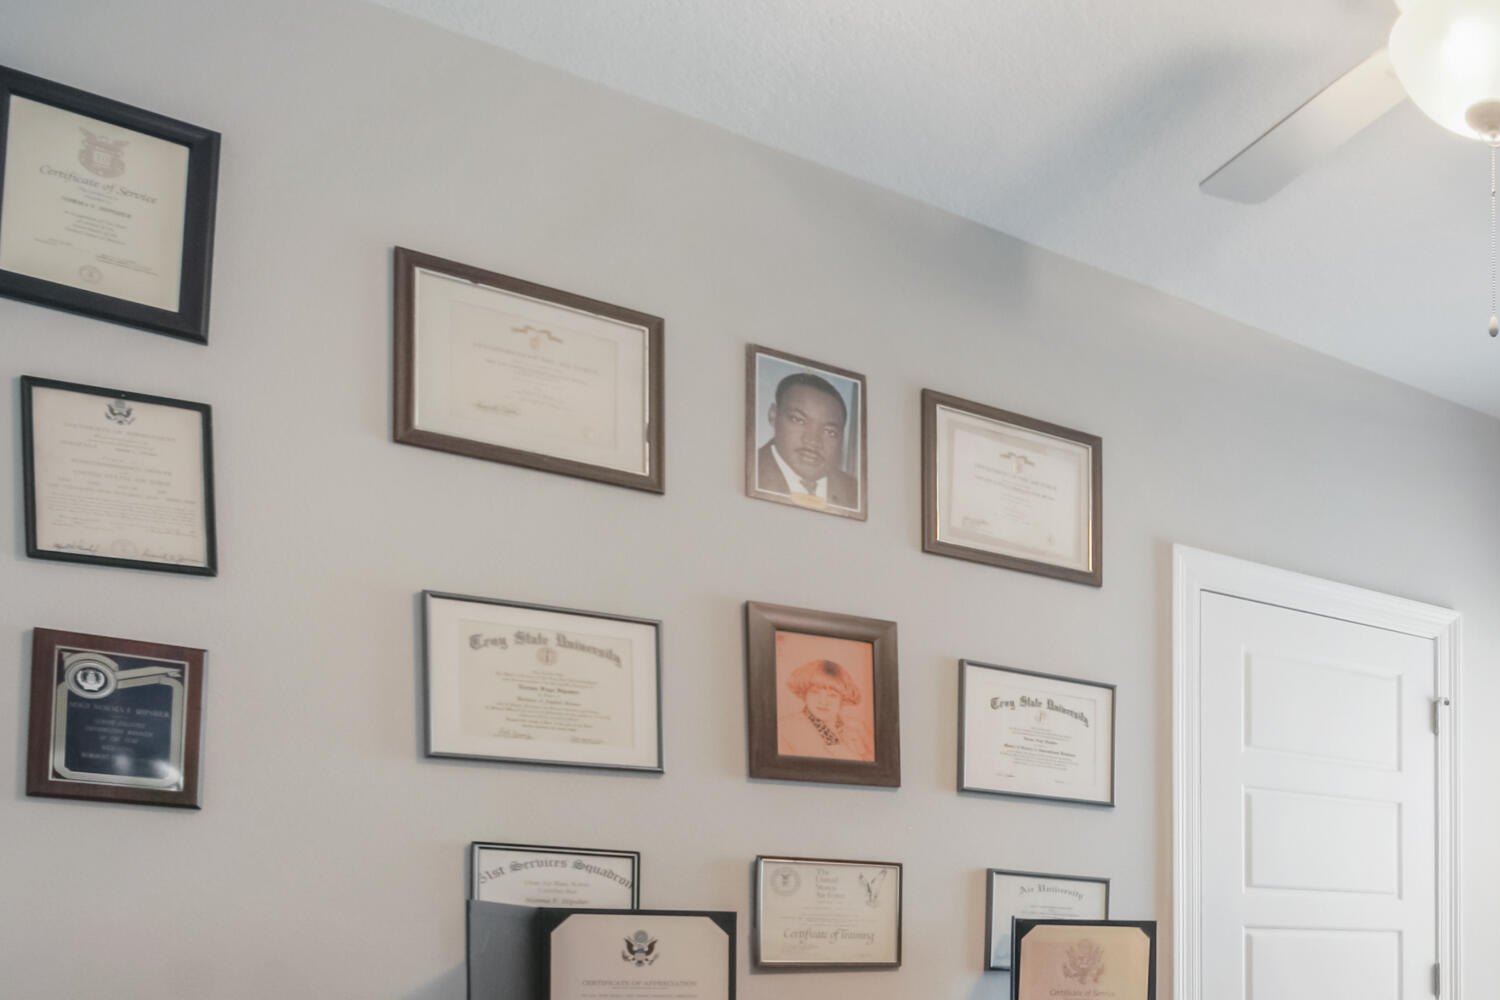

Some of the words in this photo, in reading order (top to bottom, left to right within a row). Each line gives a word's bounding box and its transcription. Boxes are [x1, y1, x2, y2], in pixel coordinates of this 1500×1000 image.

[556, 633, 623, 669] University
[1046, 698, 1089, 729] University
[509, 858, 568, 873] Services
[572, 858, 633, 890] Squadron
[1037, 883, 1084, 901] University
[783, 927, 827, 944] Certificate
